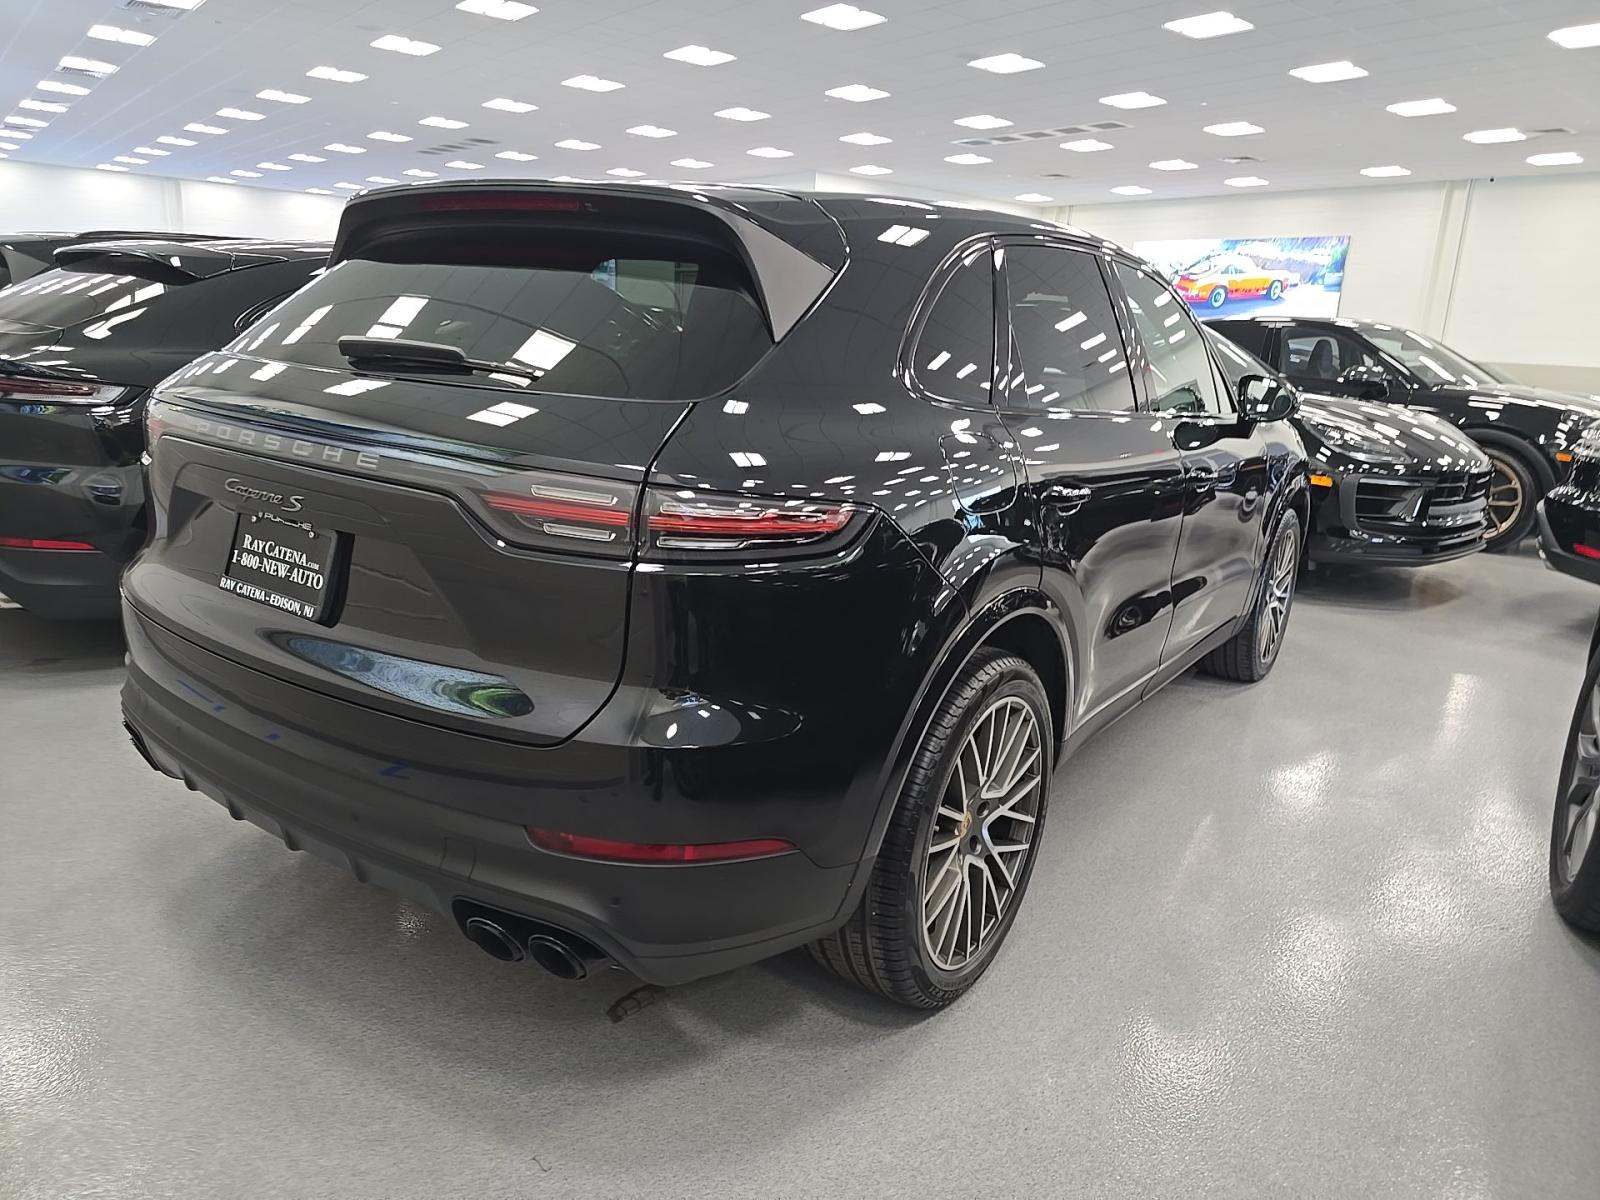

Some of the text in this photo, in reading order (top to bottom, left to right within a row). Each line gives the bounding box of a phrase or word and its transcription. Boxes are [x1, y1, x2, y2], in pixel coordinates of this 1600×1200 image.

[197, 422, 380, 470] PORSCHE
[224, 478, 304, 512] Cayenne S
[231, 549, 324, 590] 1-800-NEW-AUTO
[220, 577, 237, 591] RAY
[303, 605, 315, 618] NJ
